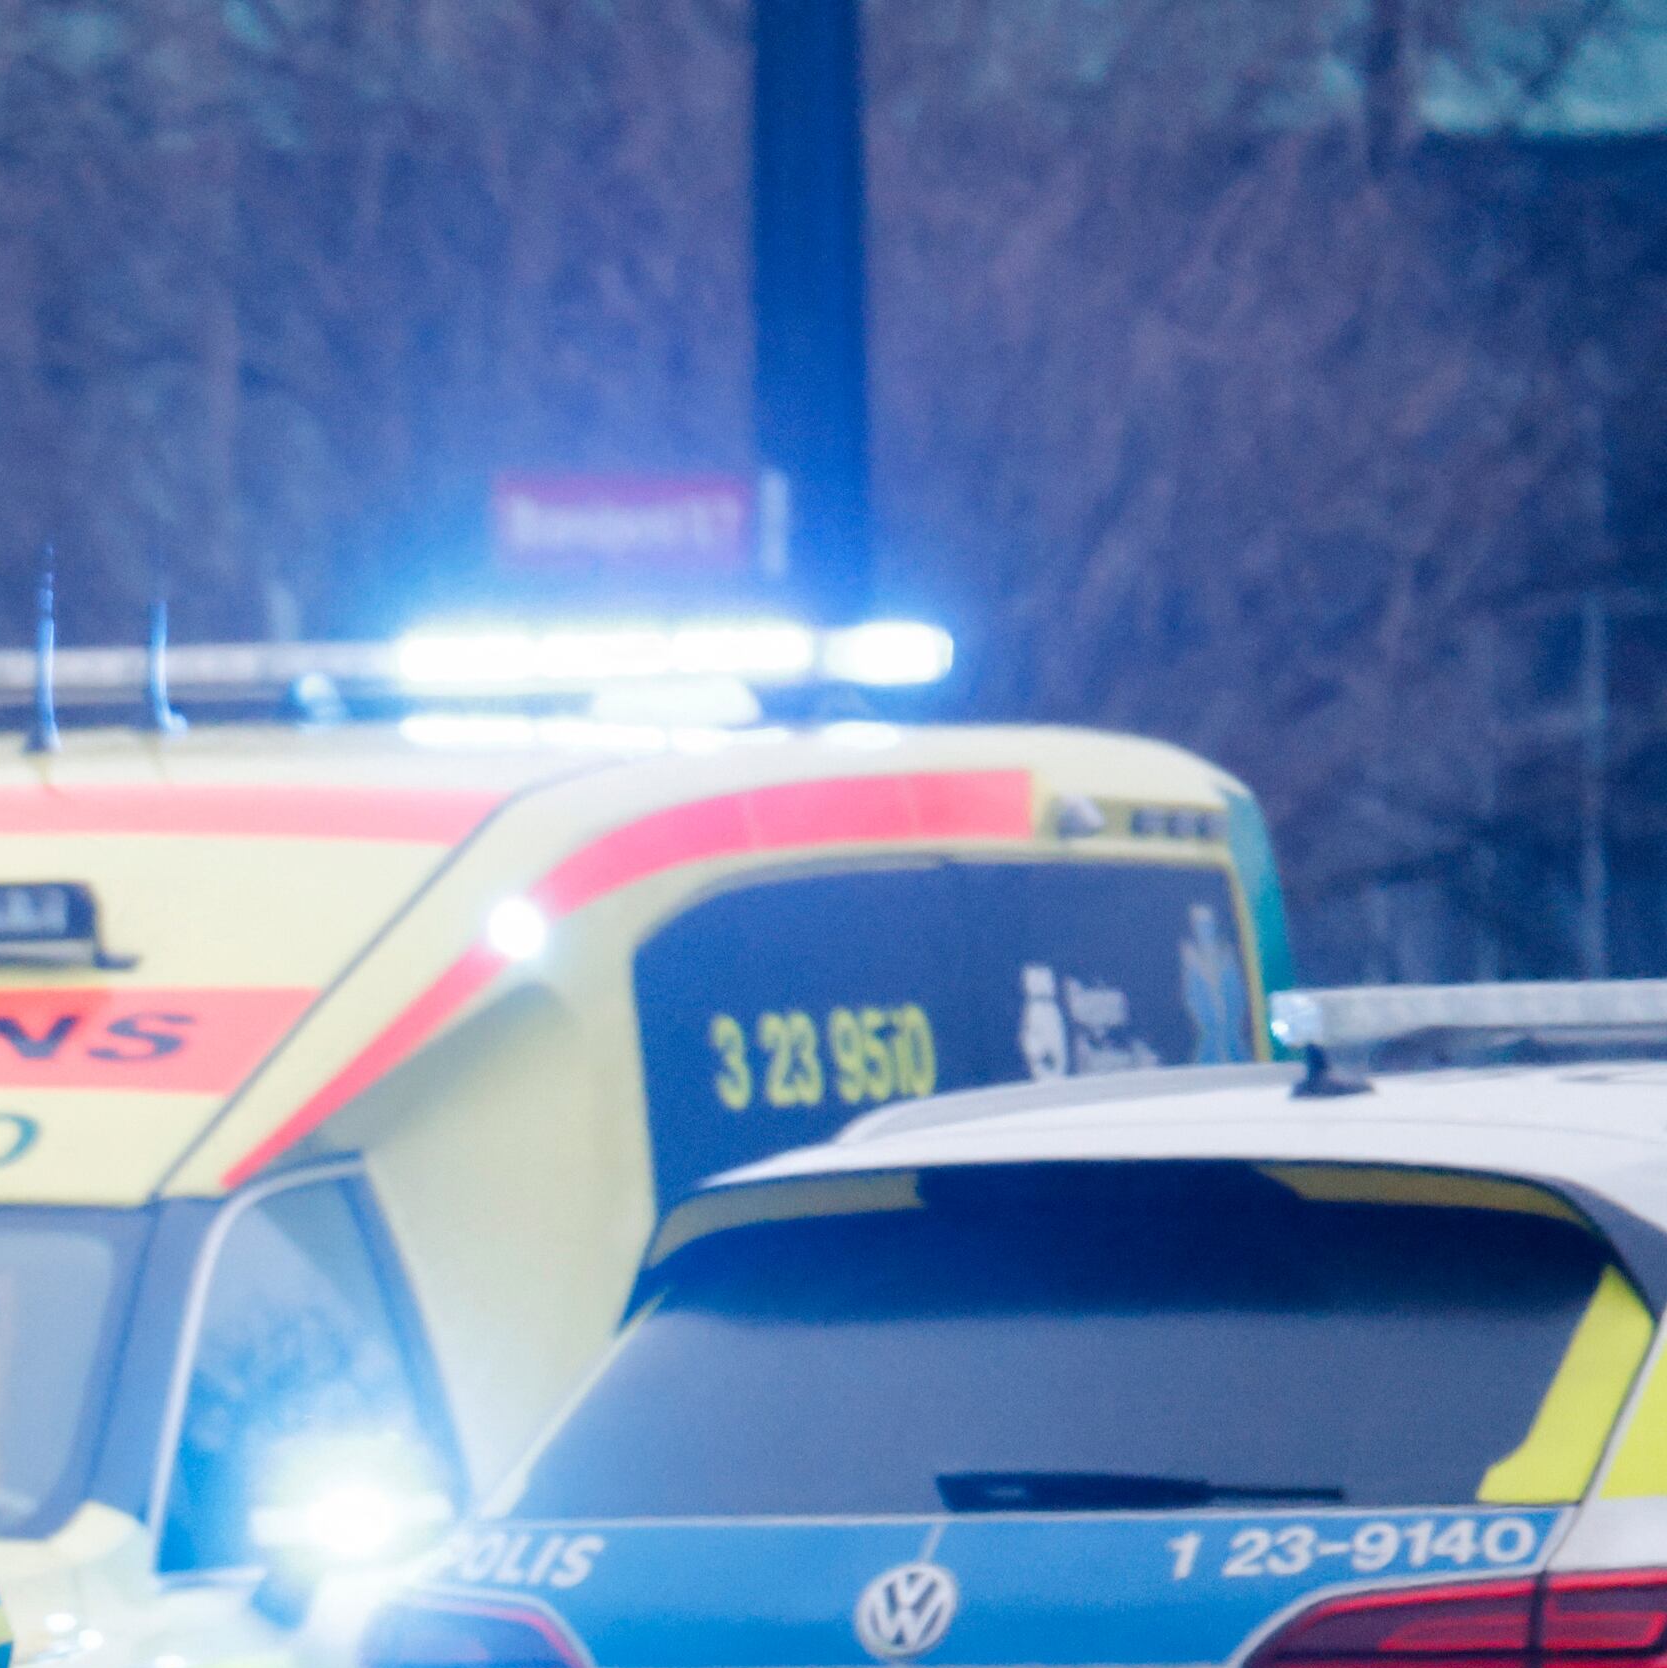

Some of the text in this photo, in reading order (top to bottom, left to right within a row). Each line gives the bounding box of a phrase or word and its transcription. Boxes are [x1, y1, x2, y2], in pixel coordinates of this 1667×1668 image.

[711, 1002, 937, 1112] 3 23 9510
[1170, 1516, 1536, 1580] 1 23-9140
[859, 1565, 954, 1656] VW
